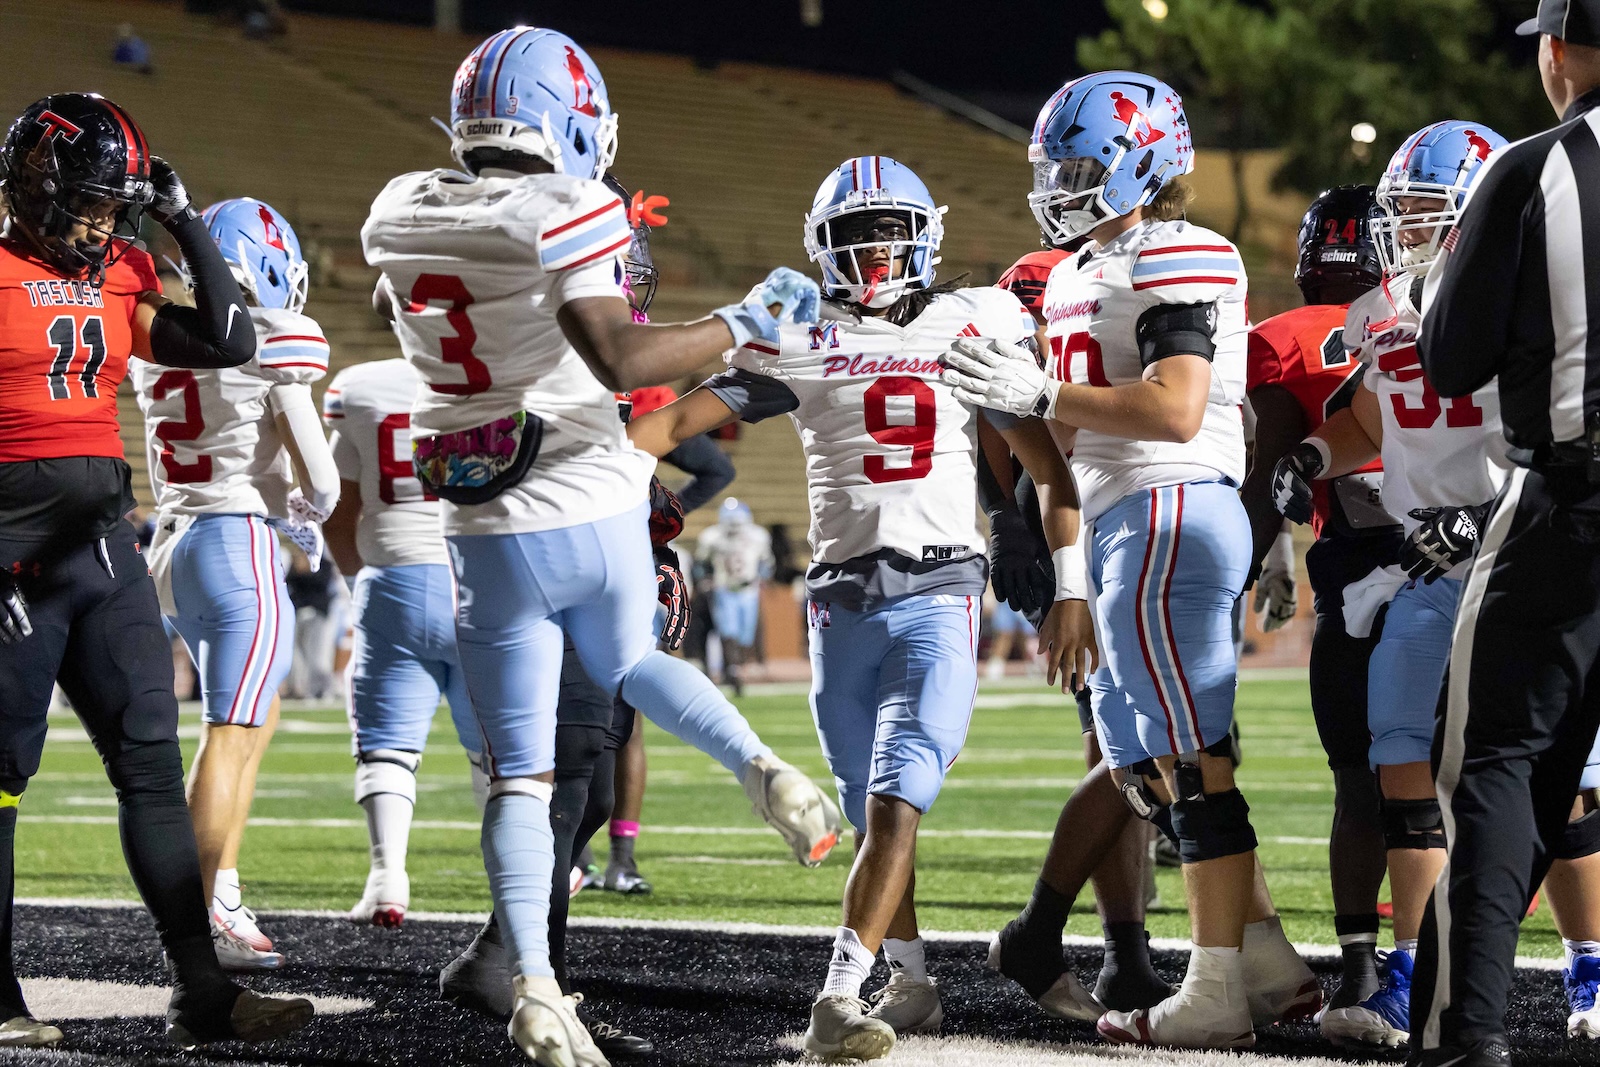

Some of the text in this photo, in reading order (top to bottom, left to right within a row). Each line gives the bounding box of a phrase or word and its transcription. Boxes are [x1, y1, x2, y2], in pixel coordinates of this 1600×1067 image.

[507, 96, 519, 114] 3
[467, 120, 503, 135] schutt
[1324, 219, 1356, 245] 24
[1321, 249, 1357, 262] schutt
[22, 280, 105, 308] TASCOSA
[404, 273, 492, 395] 3
[807, 323, 840, 351] M
[46, 315, 108, 401] 11
[822, 352, 946, 378] Plainsm
[153, 370, 213, 484] 2
[863, 376, 936, 485] 9
